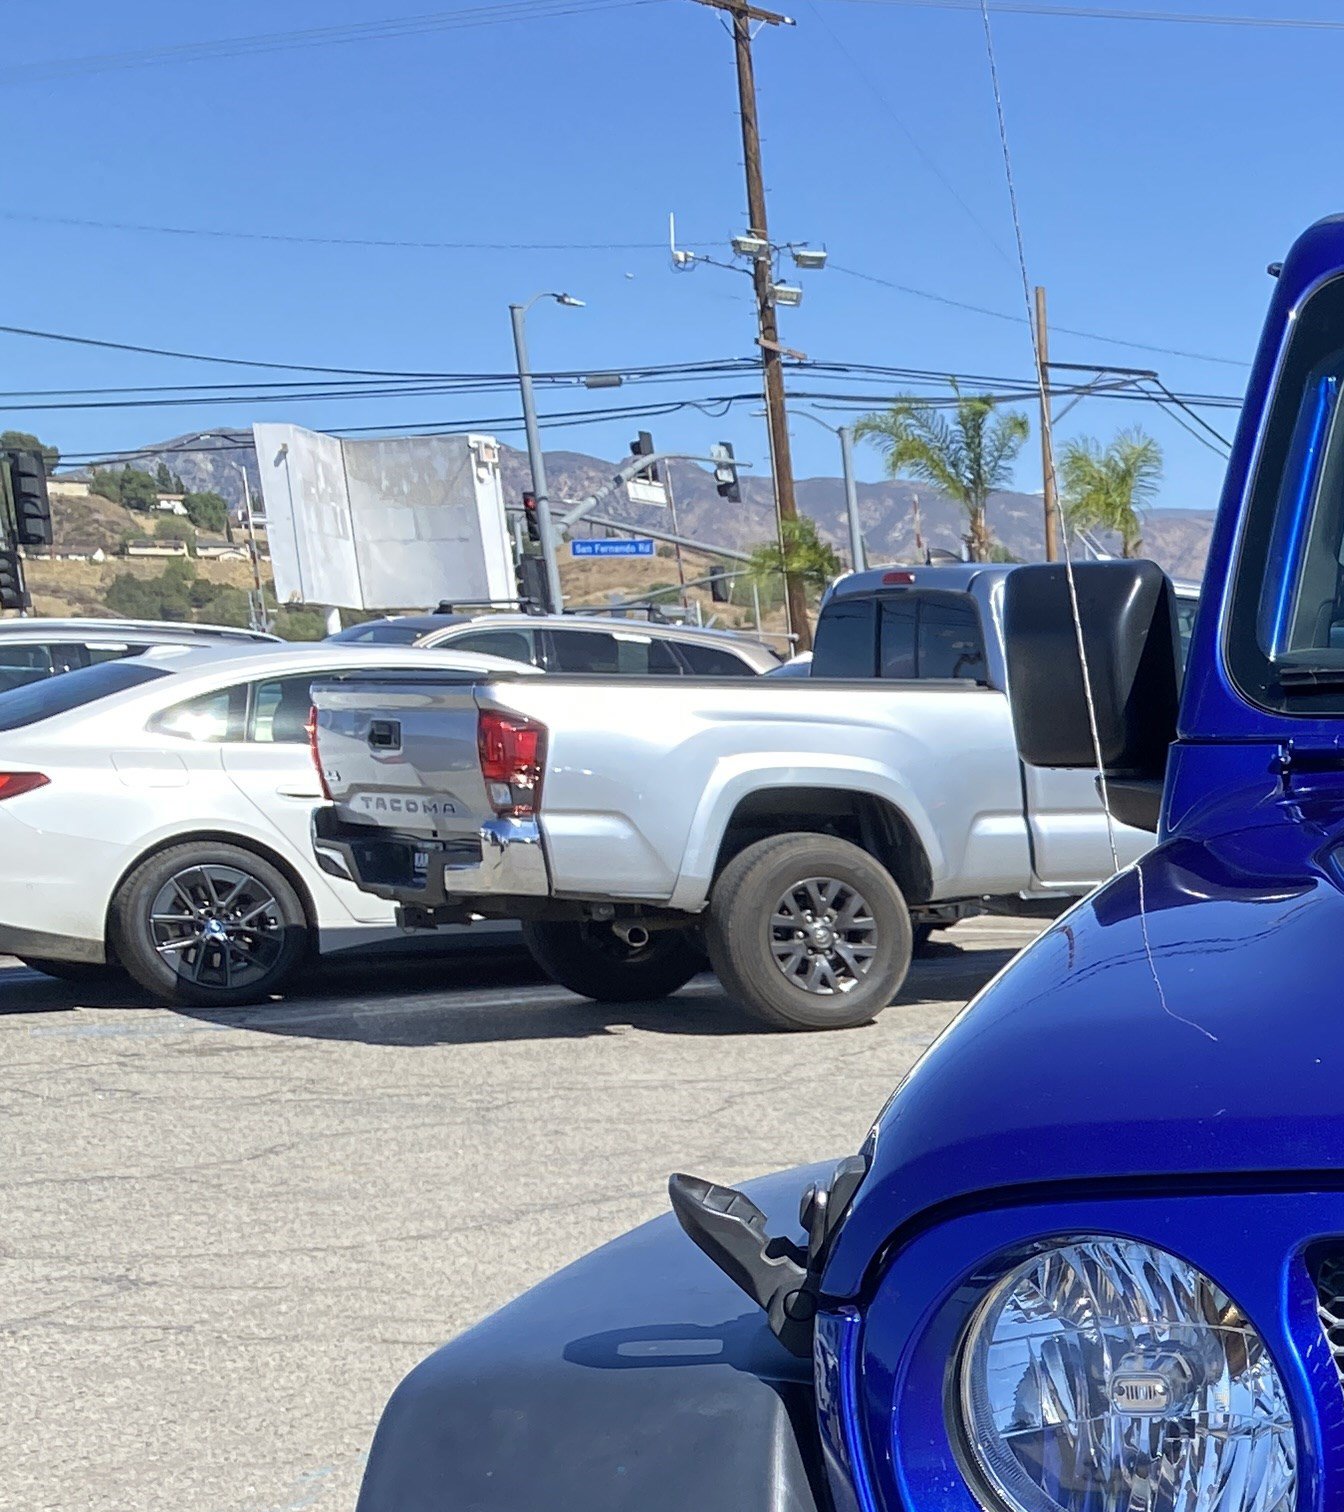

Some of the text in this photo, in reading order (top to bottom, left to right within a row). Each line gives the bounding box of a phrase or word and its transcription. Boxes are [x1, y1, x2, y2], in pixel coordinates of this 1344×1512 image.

[575, 542, 651, 554] San Fernando Rd
[360, 796, 457, 814] TACOMA
